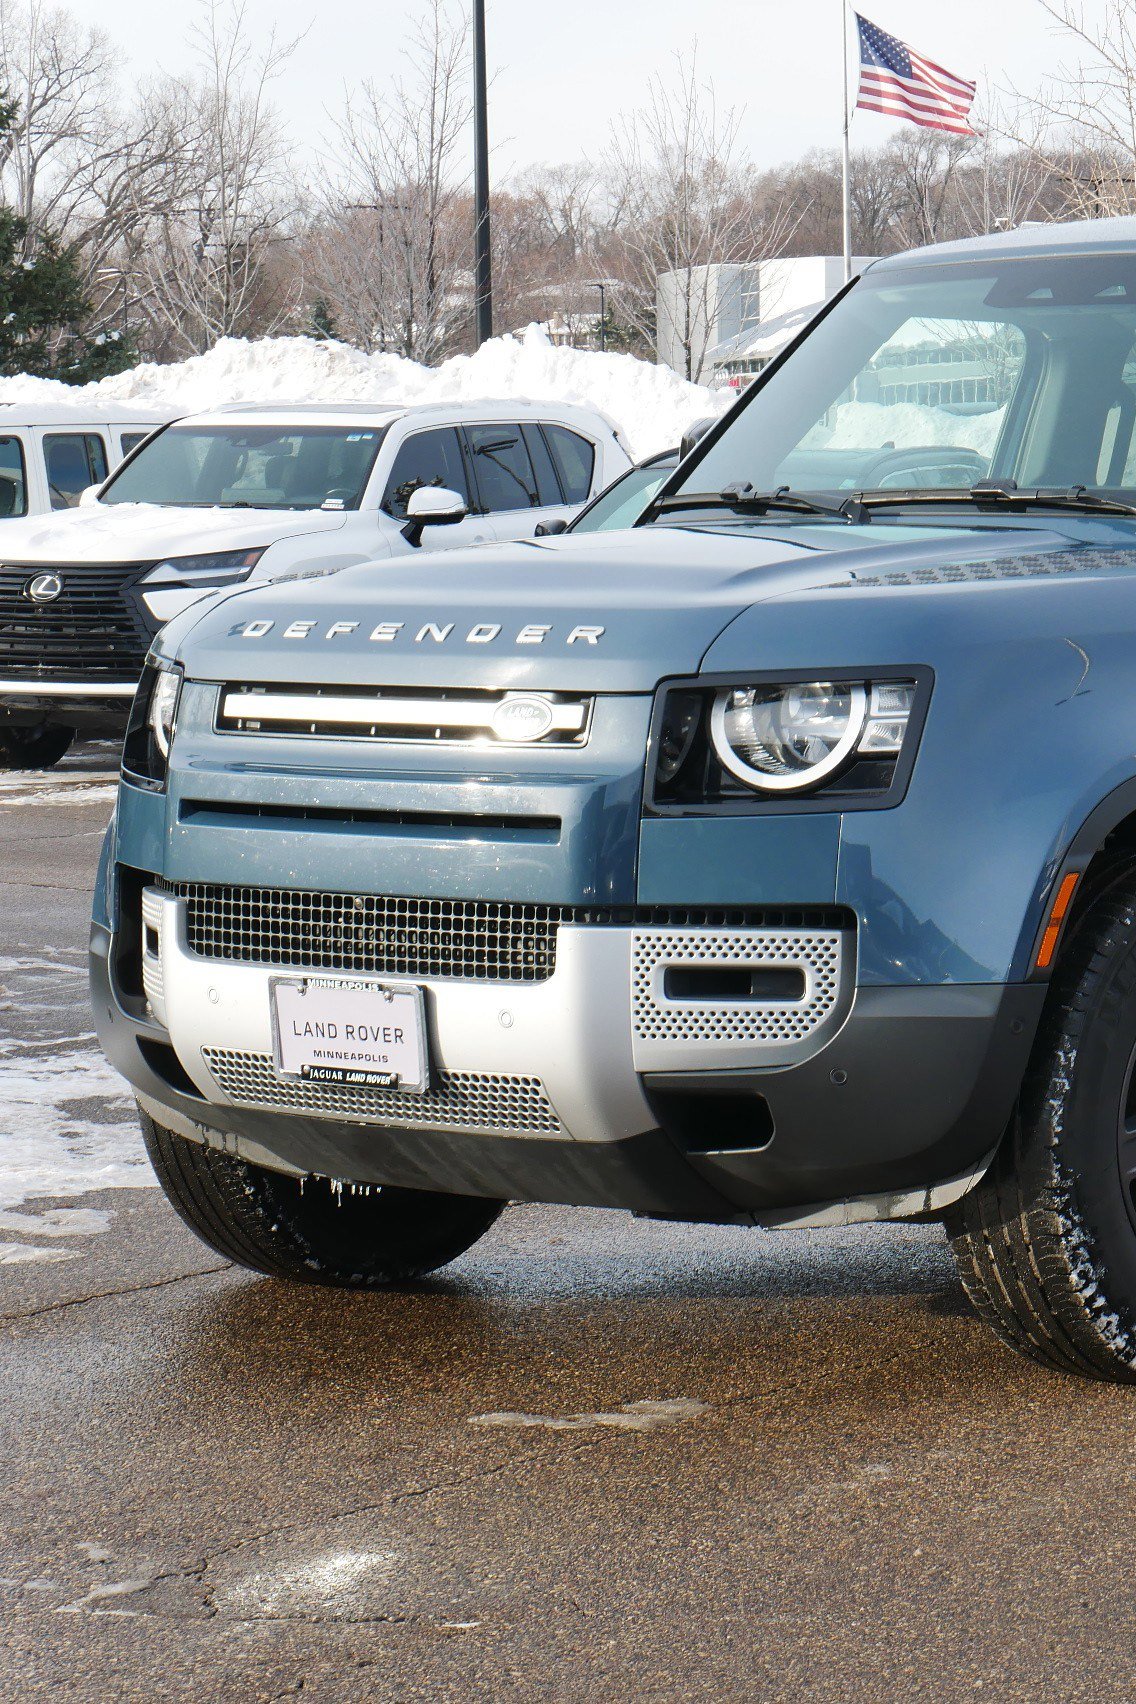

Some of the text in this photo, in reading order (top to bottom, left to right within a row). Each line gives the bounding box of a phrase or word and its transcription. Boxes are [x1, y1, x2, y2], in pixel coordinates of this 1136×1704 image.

[242, 619, 606, 645] DEFENDER
[307, 978, 379, 993] MINNEAPOLIS
[293, 1020, 405, 1044] LAND ROVER
[313, 1049, 389, 1063] MINNEAPOLIS
[309, 1068, 391, 1085] JAGUAR LAND ROVER
